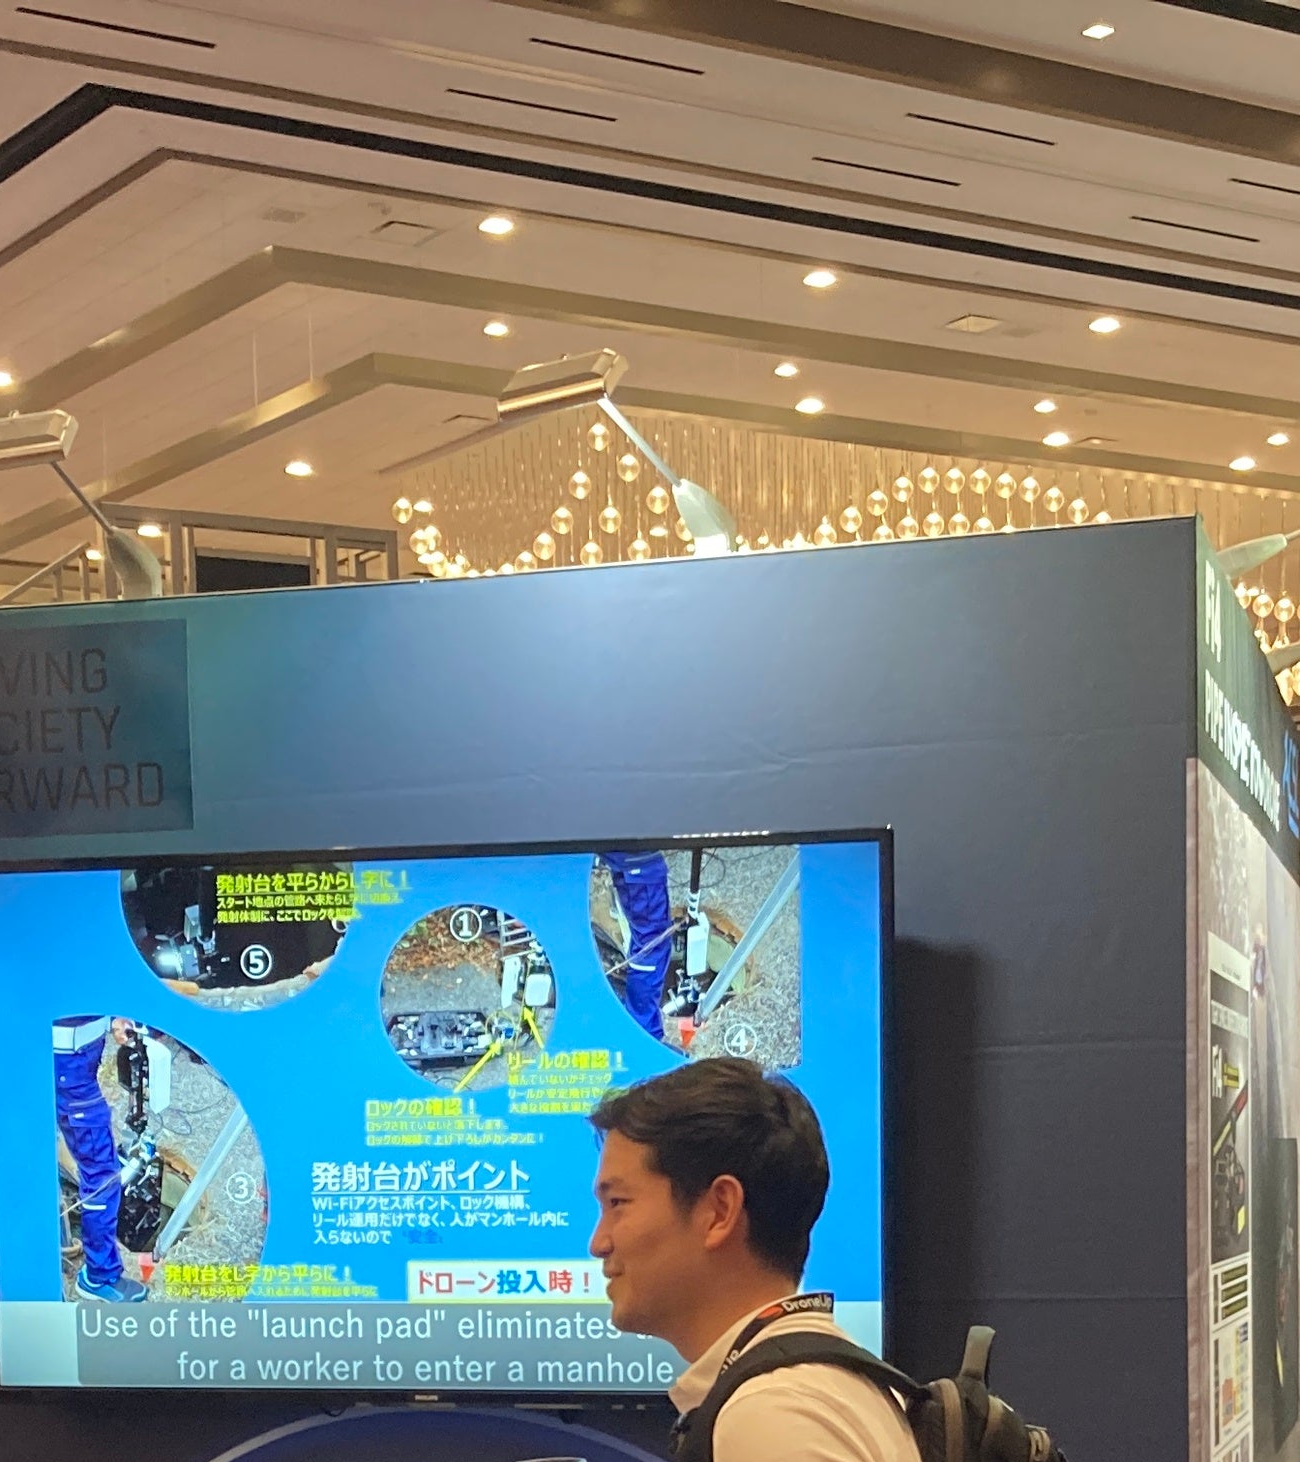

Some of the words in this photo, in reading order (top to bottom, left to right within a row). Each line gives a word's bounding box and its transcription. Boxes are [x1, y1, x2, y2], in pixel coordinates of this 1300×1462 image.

[311, 1158, 531, 1193] 発射台がポイント
[416, 1268, 591, 1295] ドローン投入時！
[81, 1309, 138, 1338] Use
[149, 1308, 179, 1338] of
[187, 1308, 237, 1338] the
[247, 1308, 363, 1338] "launch
[376, 1309, 445, 1345] pad"
[458, 1309, 622, 1340] eliminates
[177, 1352, 219, 1382] for
[229, 1360, 247, 1382] a
[257, 1351, 363, 1381] worker
[373, 1354, 403, 1381] to
[414, 1354, 496, 1382] enter
[507, 1361, 525, 1382] a
